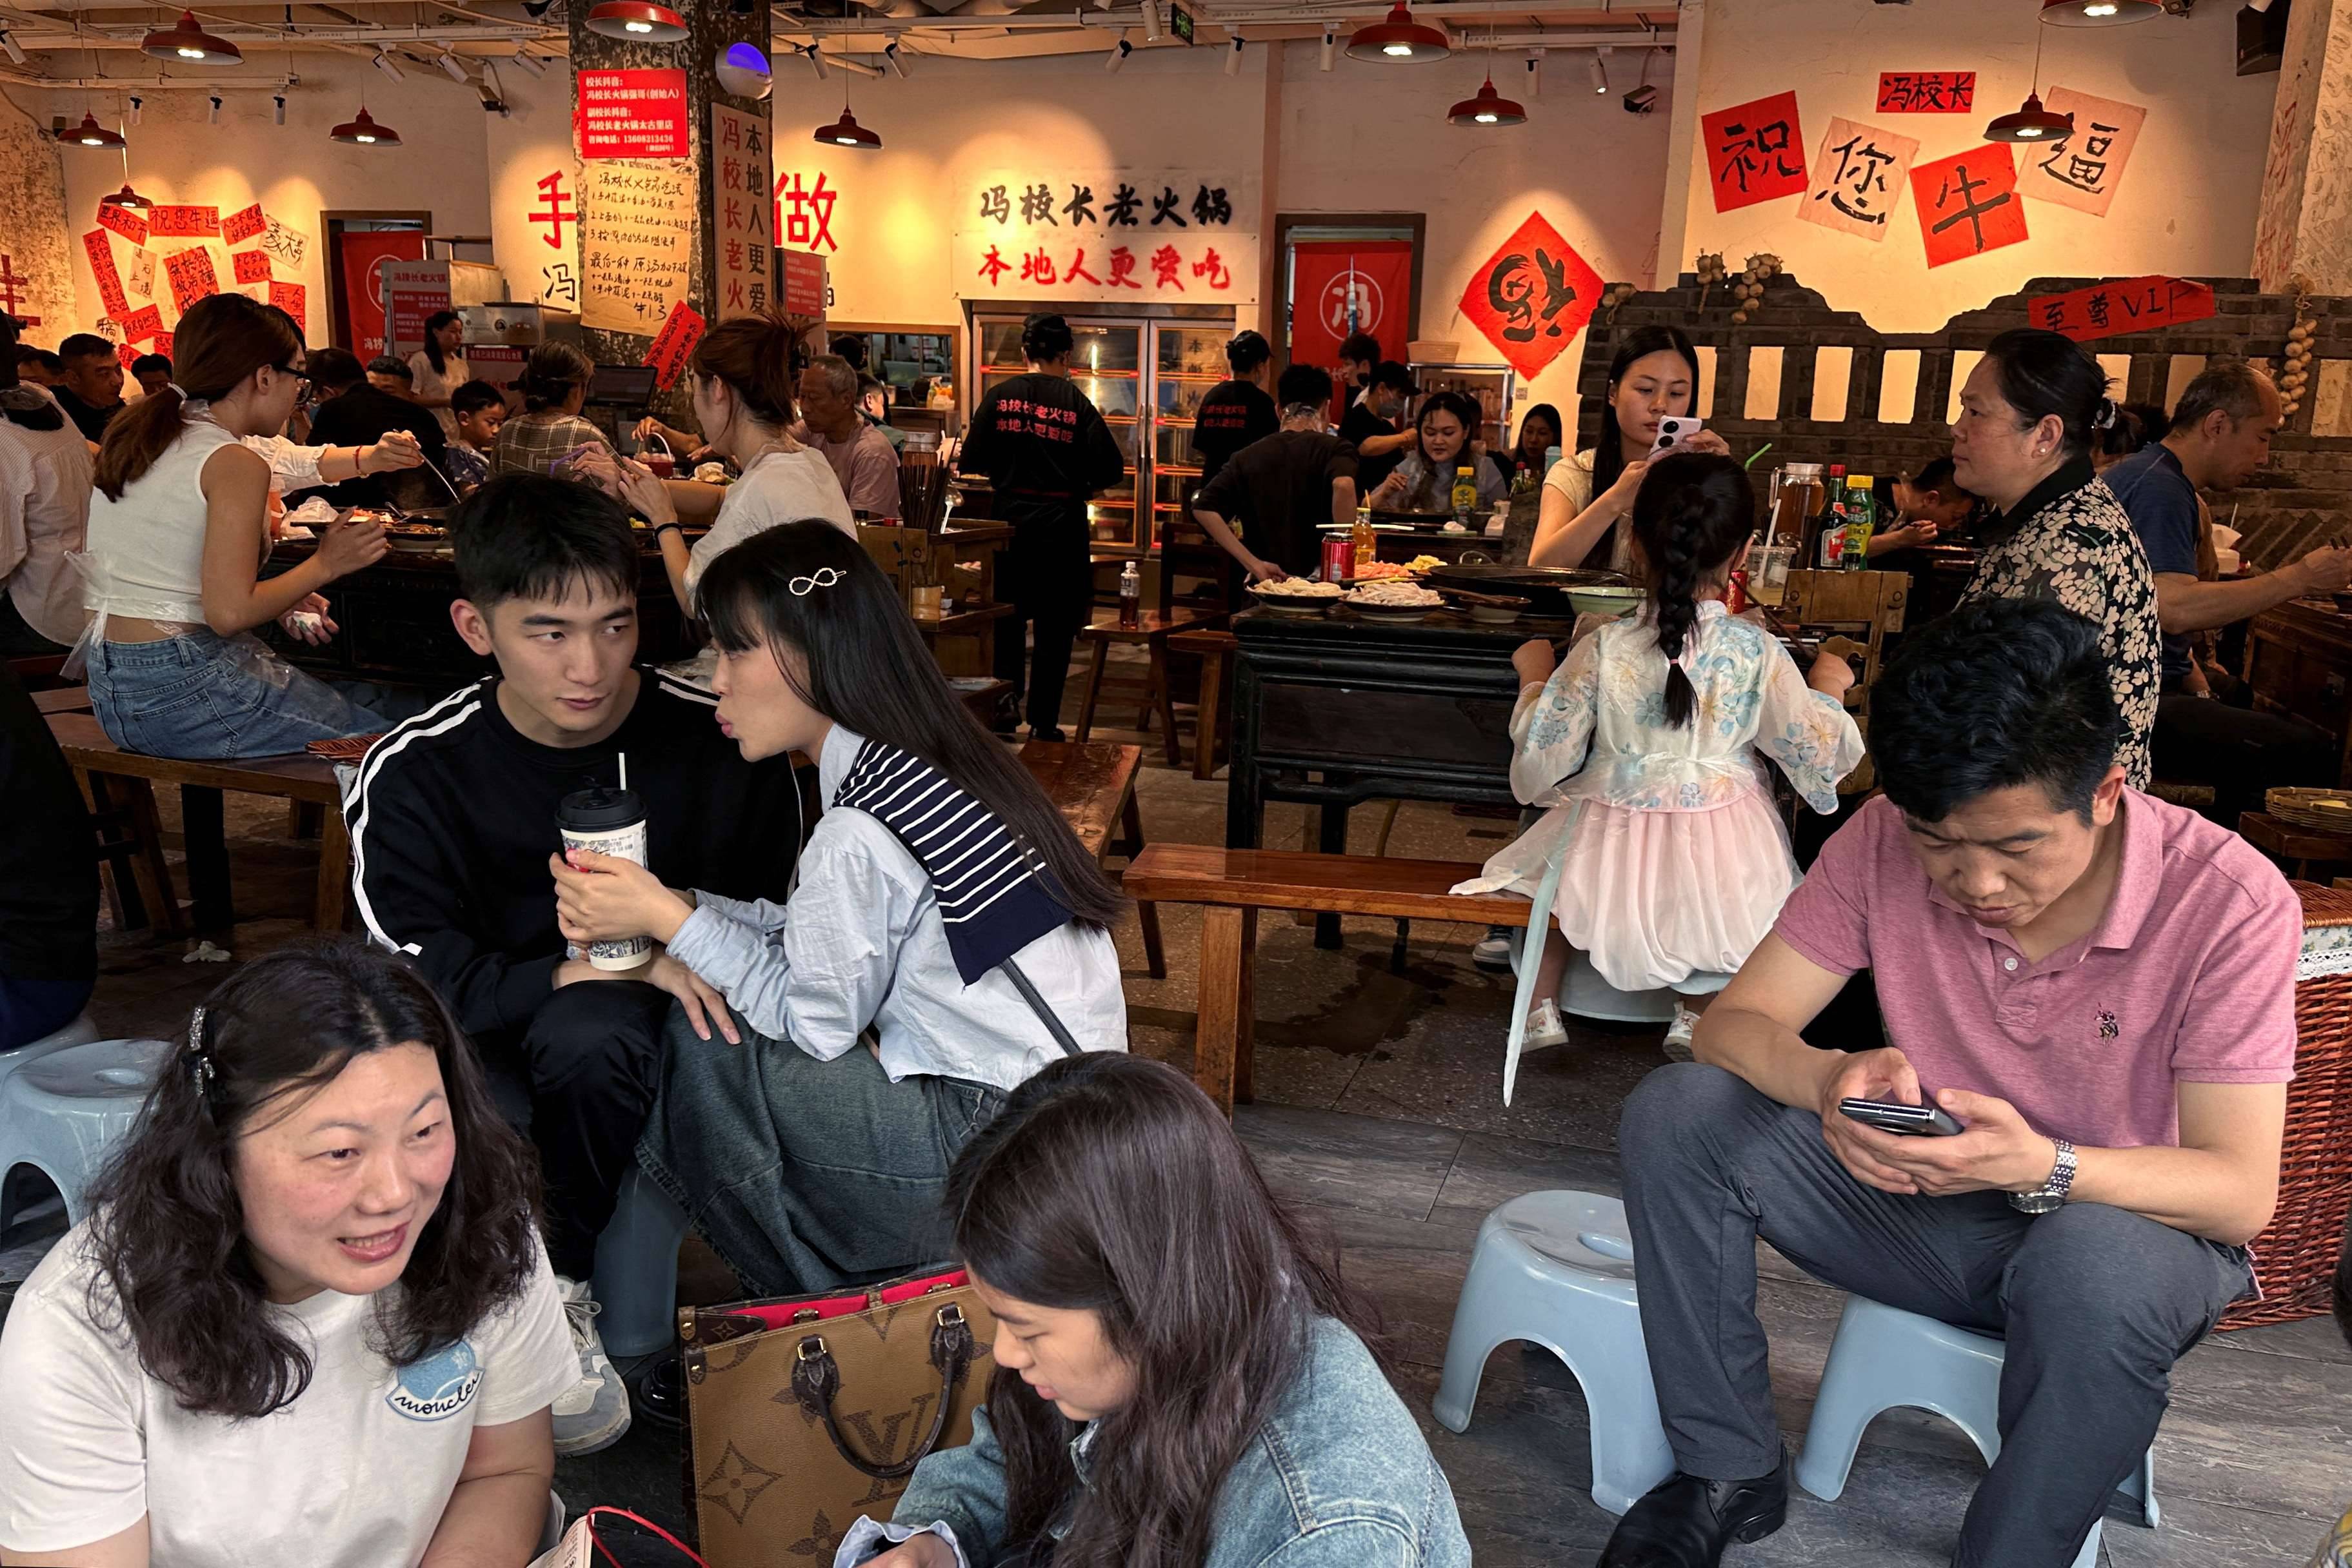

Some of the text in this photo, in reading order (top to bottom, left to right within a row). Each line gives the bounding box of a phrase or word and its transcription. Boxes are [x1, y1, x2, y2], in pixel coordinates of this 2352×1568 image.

[1880, 74, 1974, 111] 冯校长
[1720, 121, 1804, 193] 祝
[1815, 135, 1896, 225] 您
[2038, 112, 2120, 195] 逼
[99, 205, 148, 241] 世界和平
[150, 208, 219, 231] 祝您牛逼
[528, 169, 838, 253] 手 做
[980, 183, 1232, 227] 冯校长老火锅
[1931, 165, 2012, 253] 牛
[978, 243, 1231, 292] 本地人更爱吃
[1488, 248, 1577, 343] 福
